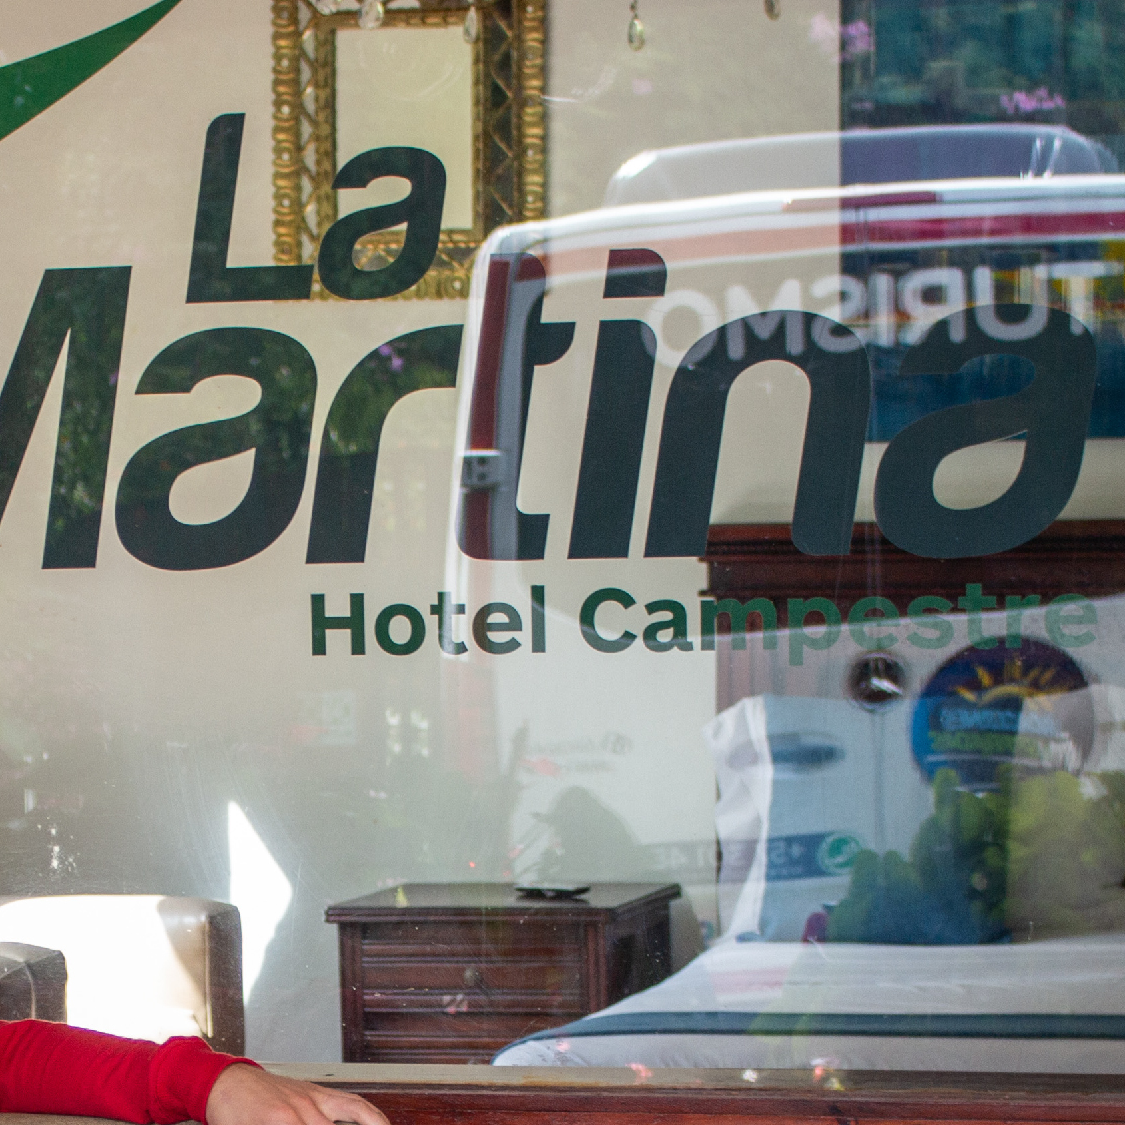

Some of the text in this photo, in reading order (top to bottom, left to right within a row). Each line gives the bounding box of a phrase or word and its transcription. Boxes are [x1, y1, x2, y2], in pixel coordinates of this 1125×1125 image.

[185, 112, 447, 304] La
[309, 583, 1097, 665] Hotel Campestre
